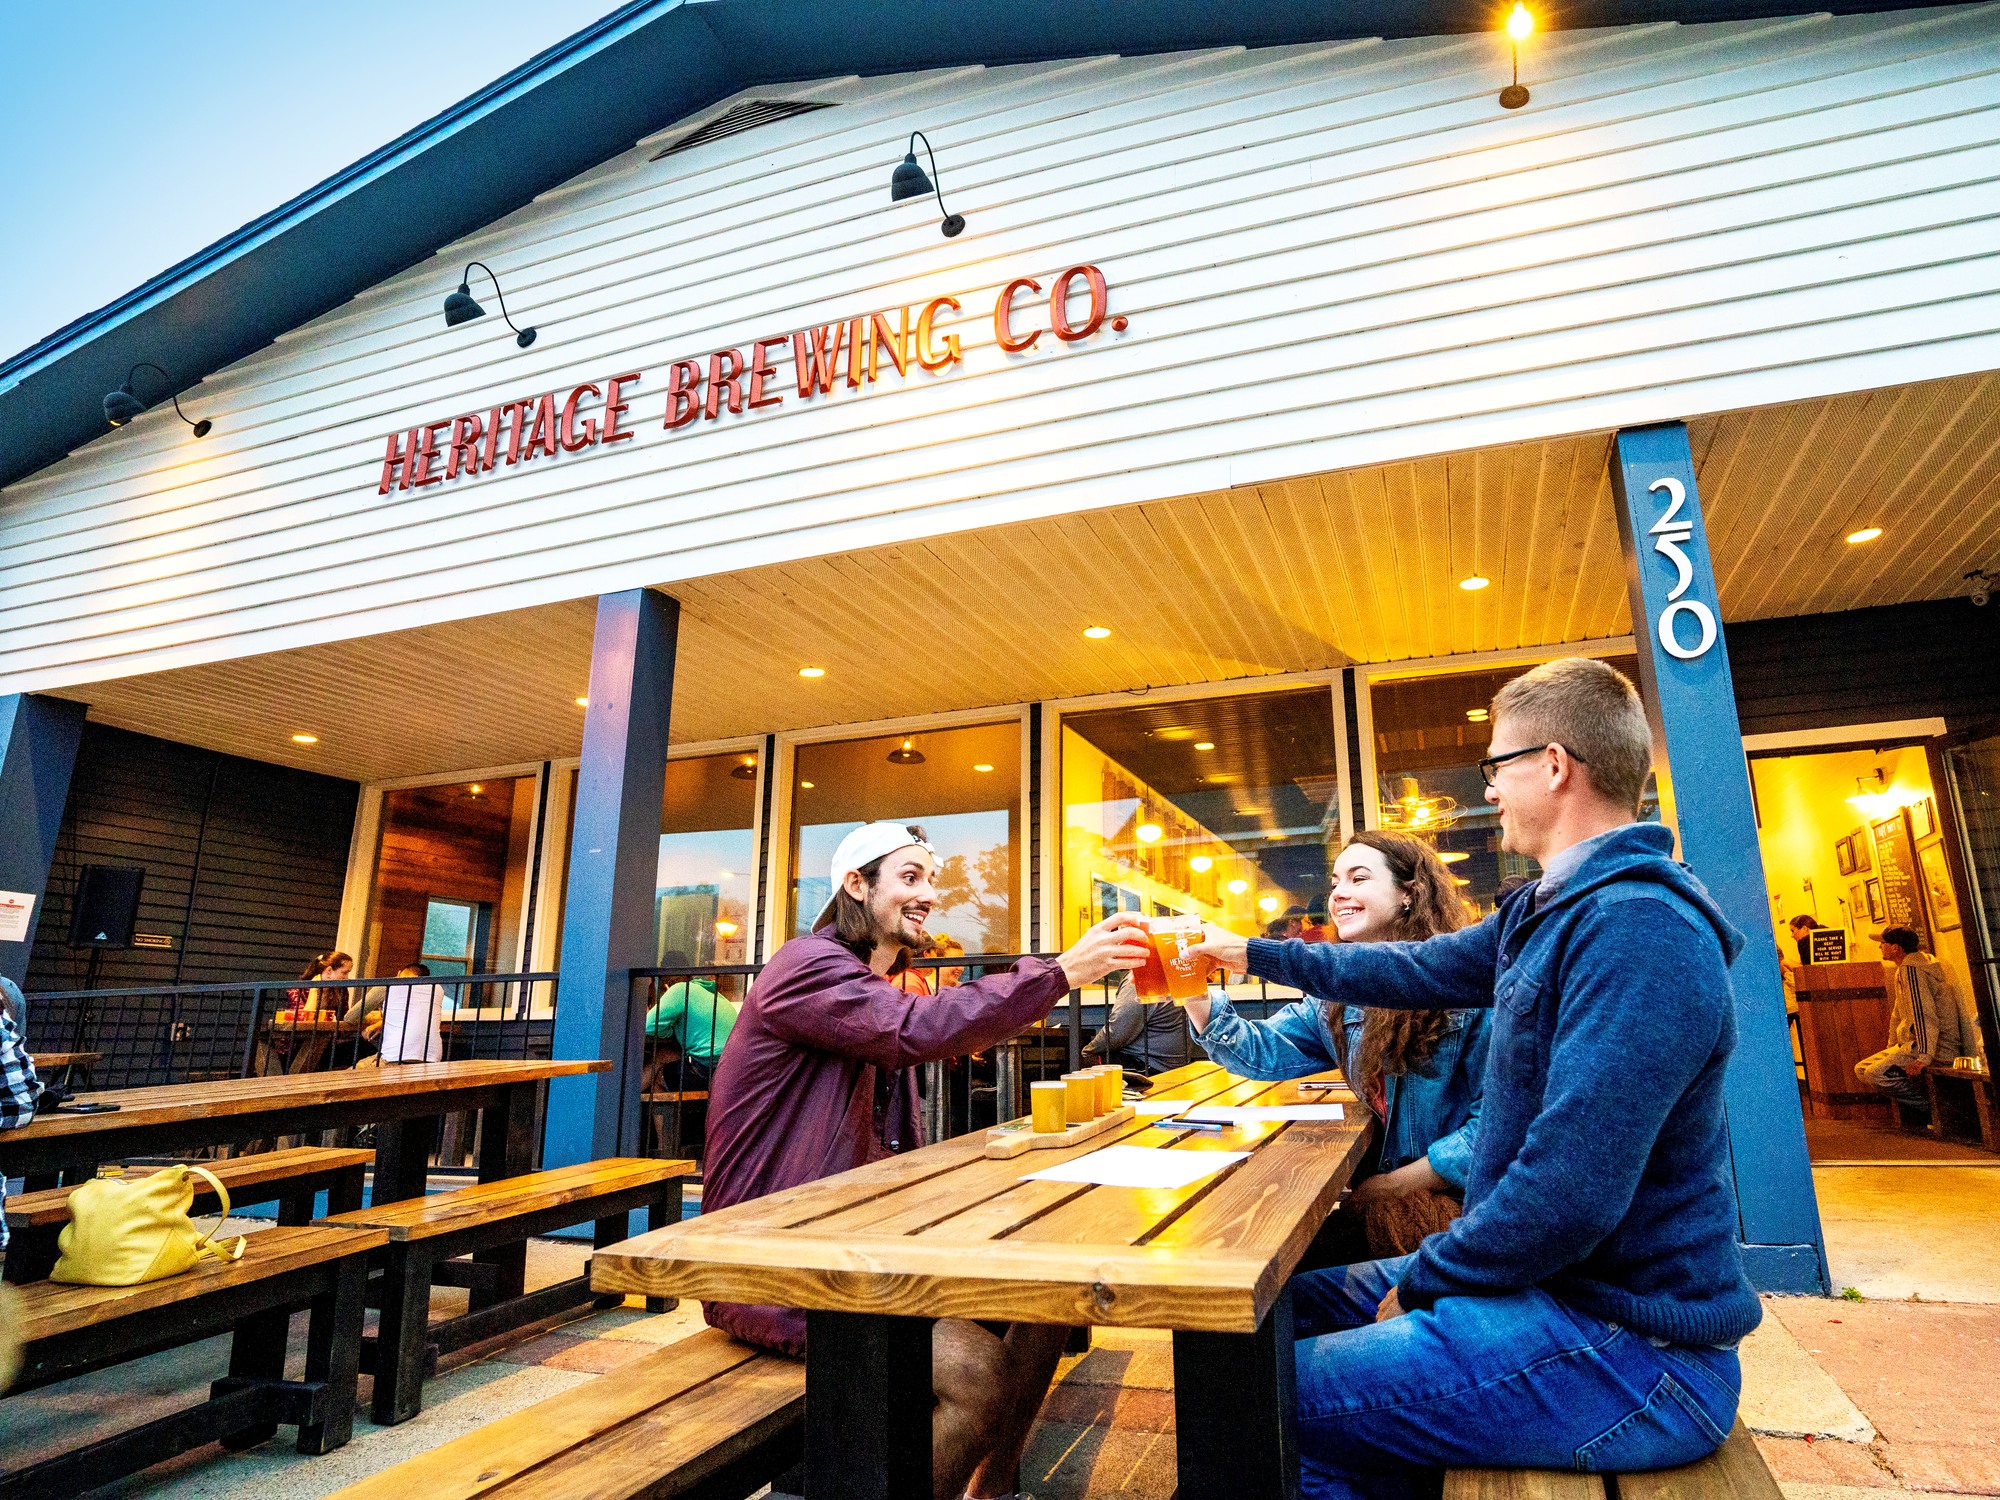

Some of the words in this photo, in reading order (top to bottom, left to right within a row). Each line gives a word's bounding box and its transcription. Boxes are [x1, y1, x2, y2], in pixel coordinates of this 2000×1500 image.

[378, 372, 641, 495] HERITAGE
[663, 295, 962, 431] BREWING
[994, 264, 1130, 354] CO.
[1648, 477, 1717, 659] 250
